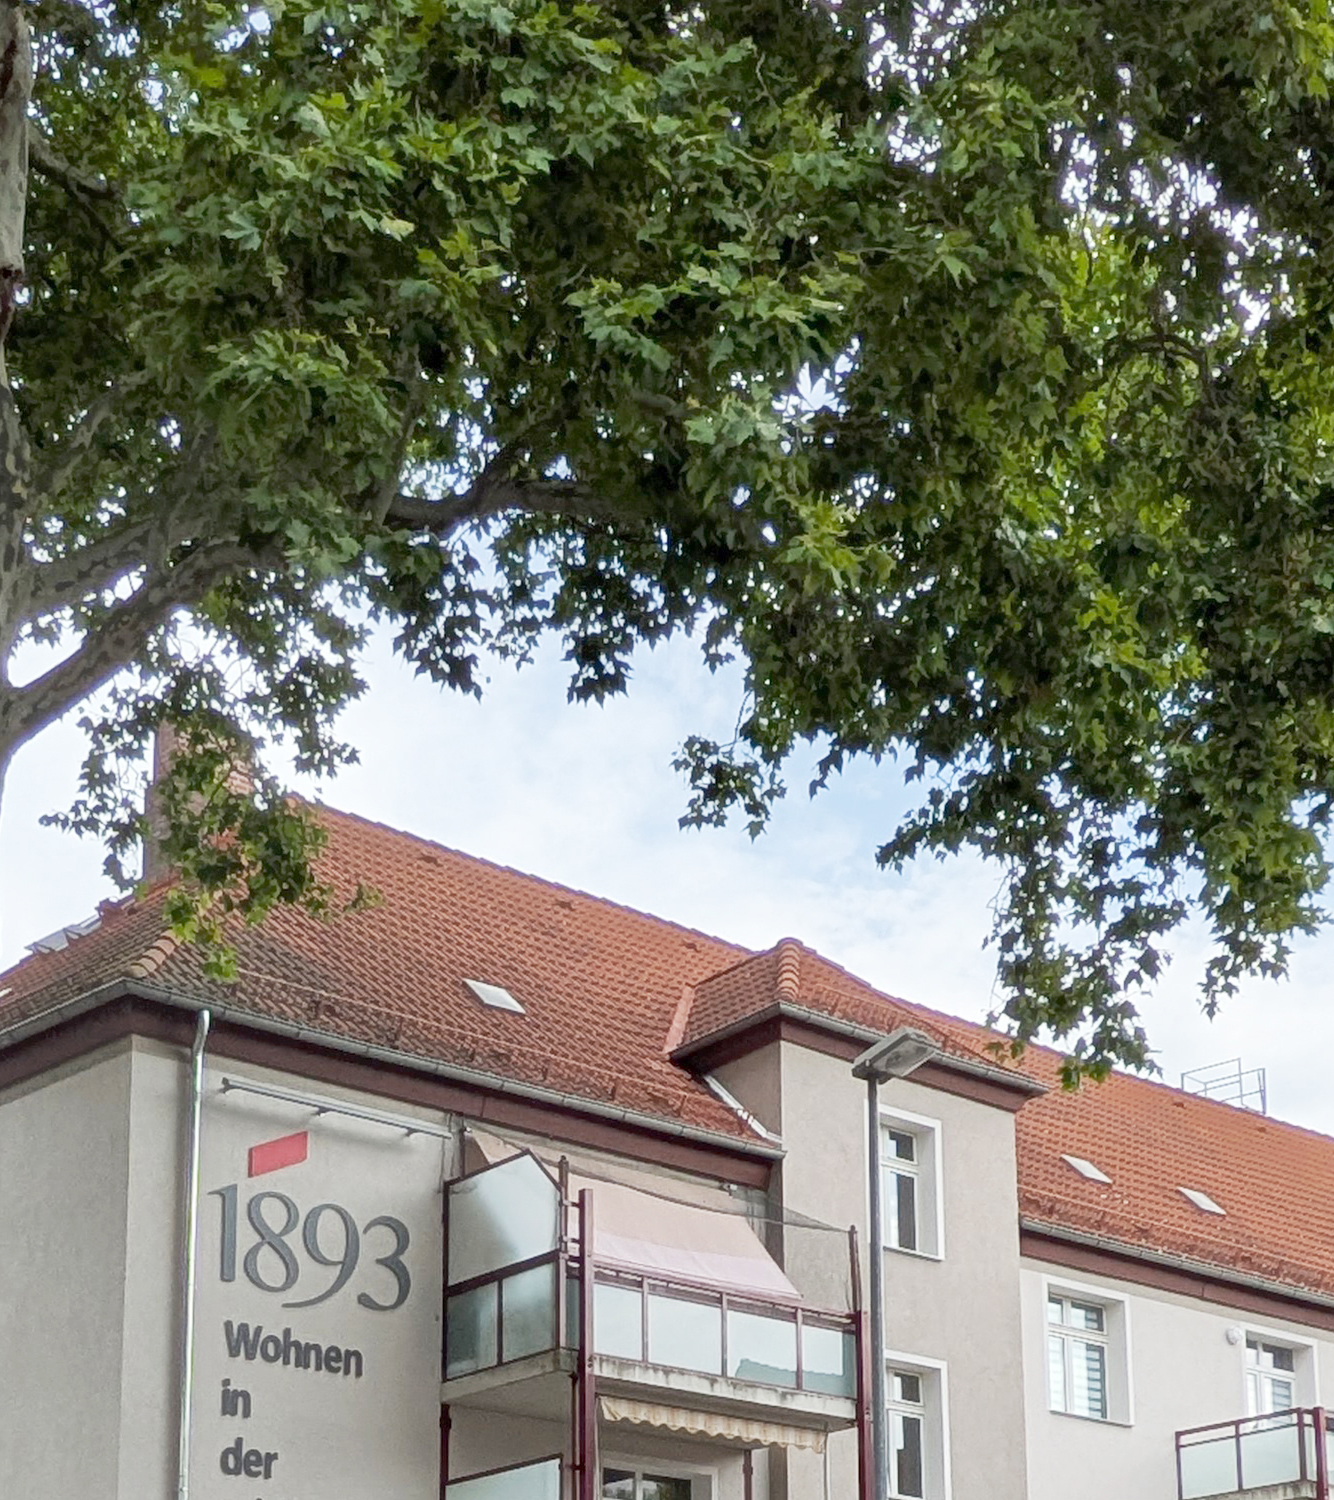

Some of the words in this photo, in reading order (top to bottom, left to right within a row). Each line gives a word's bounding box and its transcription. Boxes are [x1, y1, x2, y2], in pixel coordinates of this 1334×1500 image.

[207, 1183, 411, 1312] 1893
[223, 1319, 363, 1378] Wohnen
[220, 1378, 252, 1419] in
[219, 1436, 279, 1480] der
